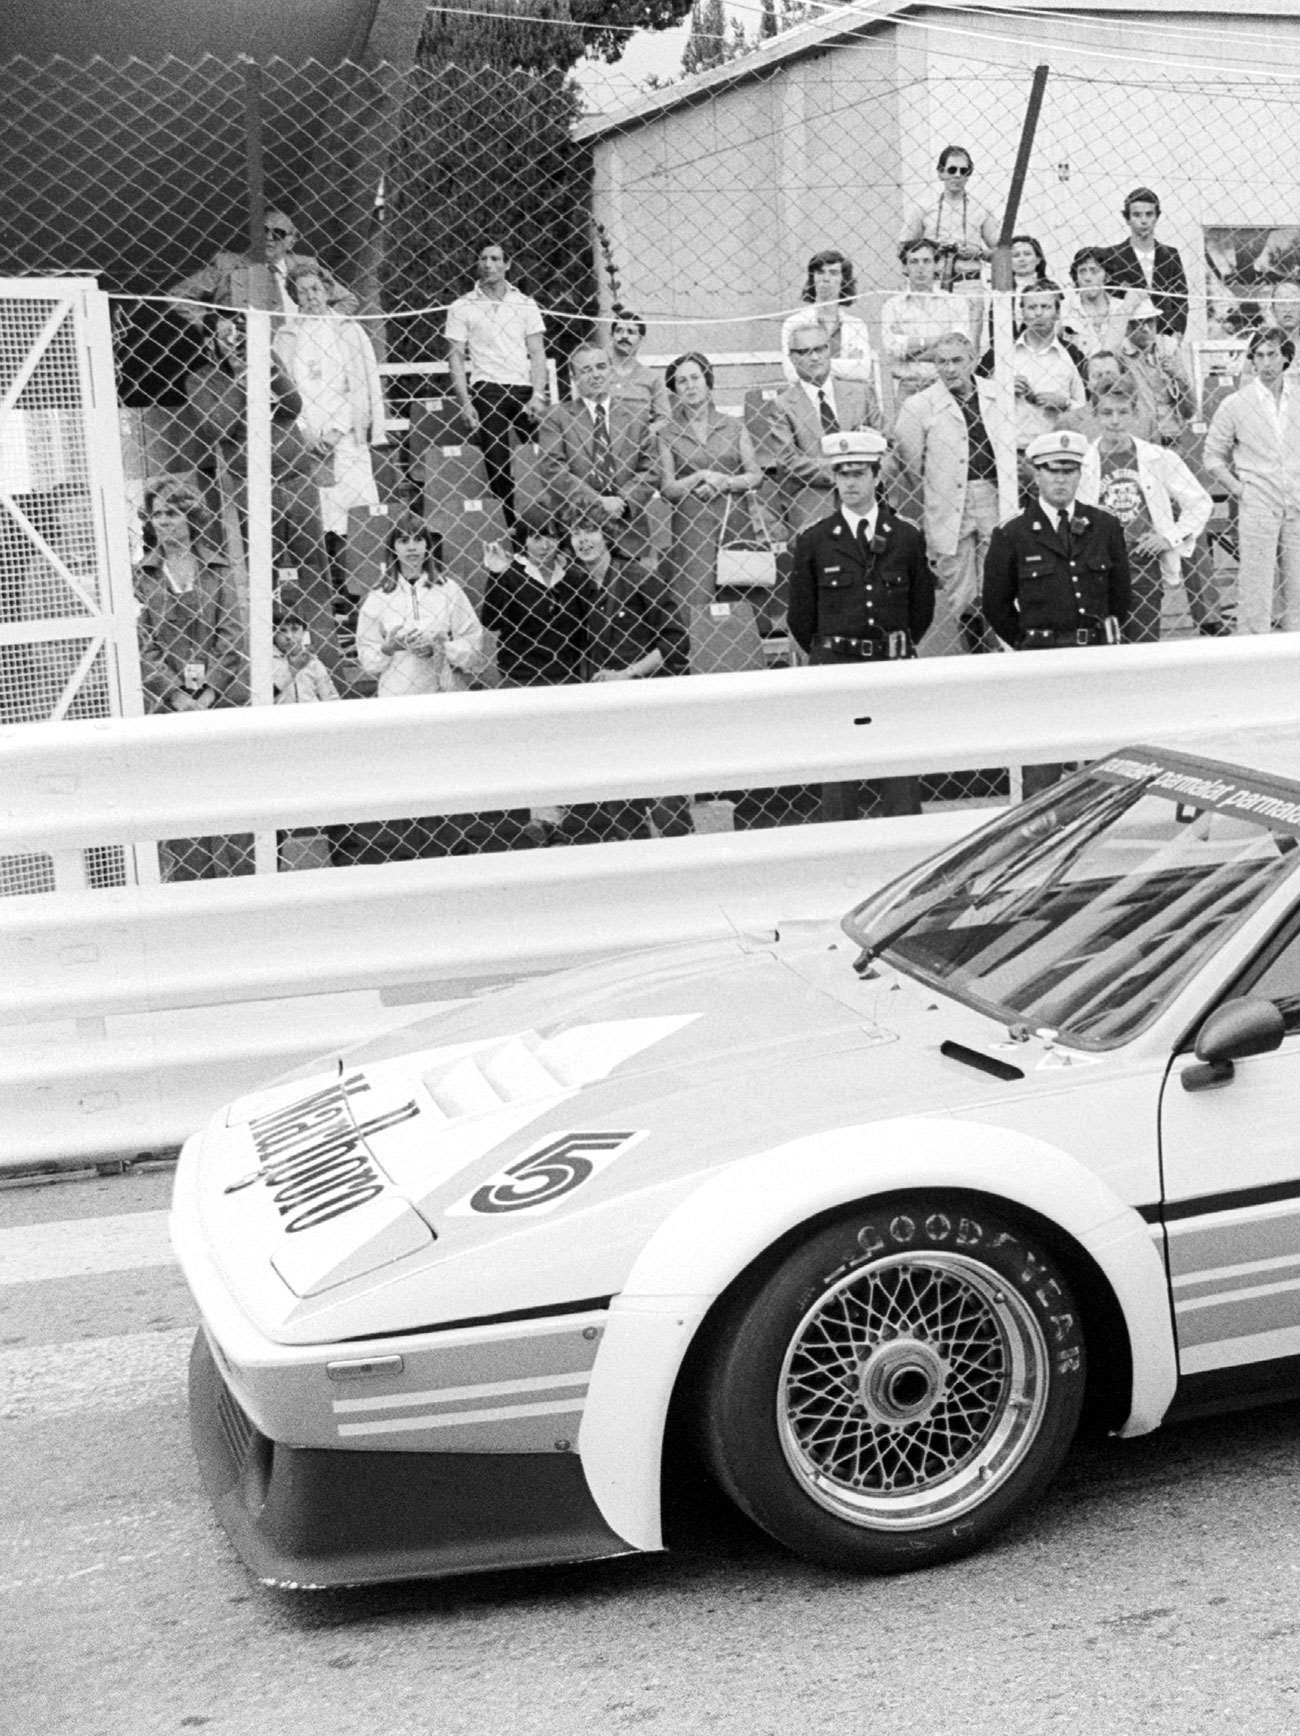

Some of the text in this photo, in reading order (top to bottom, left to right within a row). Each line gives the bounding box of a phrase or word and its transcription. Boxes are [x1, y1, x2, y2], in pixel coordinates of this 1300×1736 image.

[1146, 761, 1236, 802] parmalat
[248, 1073, 422, 1233] Marlboro
[470, 1131, 638, 1214] 5
